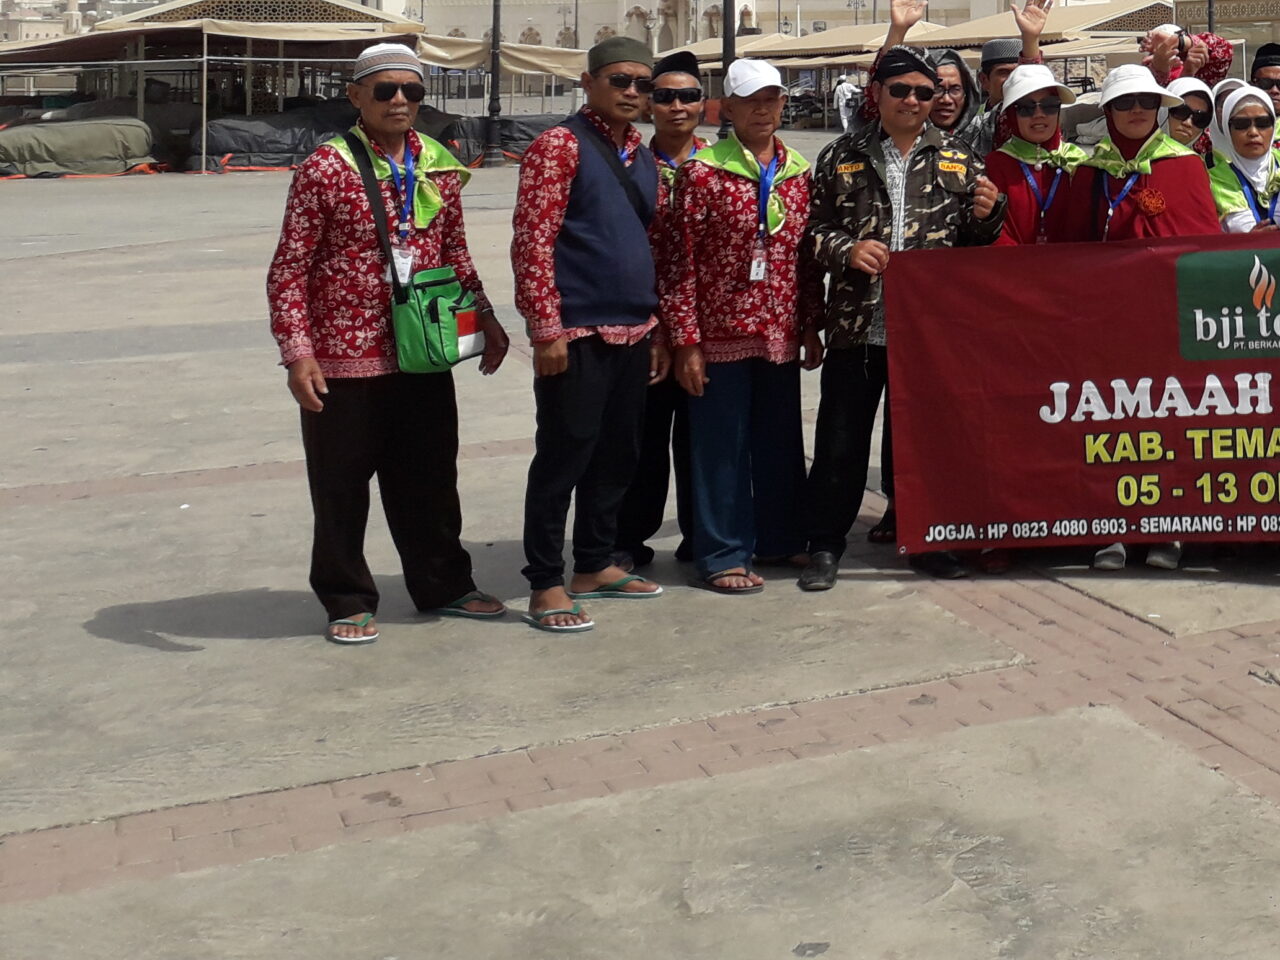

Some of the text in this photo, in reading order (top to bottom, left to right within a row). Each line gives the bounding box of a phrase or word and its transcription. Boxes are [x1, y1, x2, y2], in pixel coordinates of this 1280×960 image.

[1193, 306, 1246, 349] bji
[1233, 340, 1246, 350] PT.
[1039, 372, 1275, 424] JAMAAH
[1084, 431, 1176, 464] KAB.
[1116, 474, 1161, 506] 05
[1196, 472, 1239, 503] 13
[925, 524, 976, 542] JOGJA
[987, 523, 1008, 539] HP
[1012, 521, 1049, 538] 0823
[1052, 519, 1088, 536] 4080
[1091, 518, 1127, 535] 6903
[1140, 515, 1224, 533] SEMARANG
[1236, 515, 1257, 532] HP
